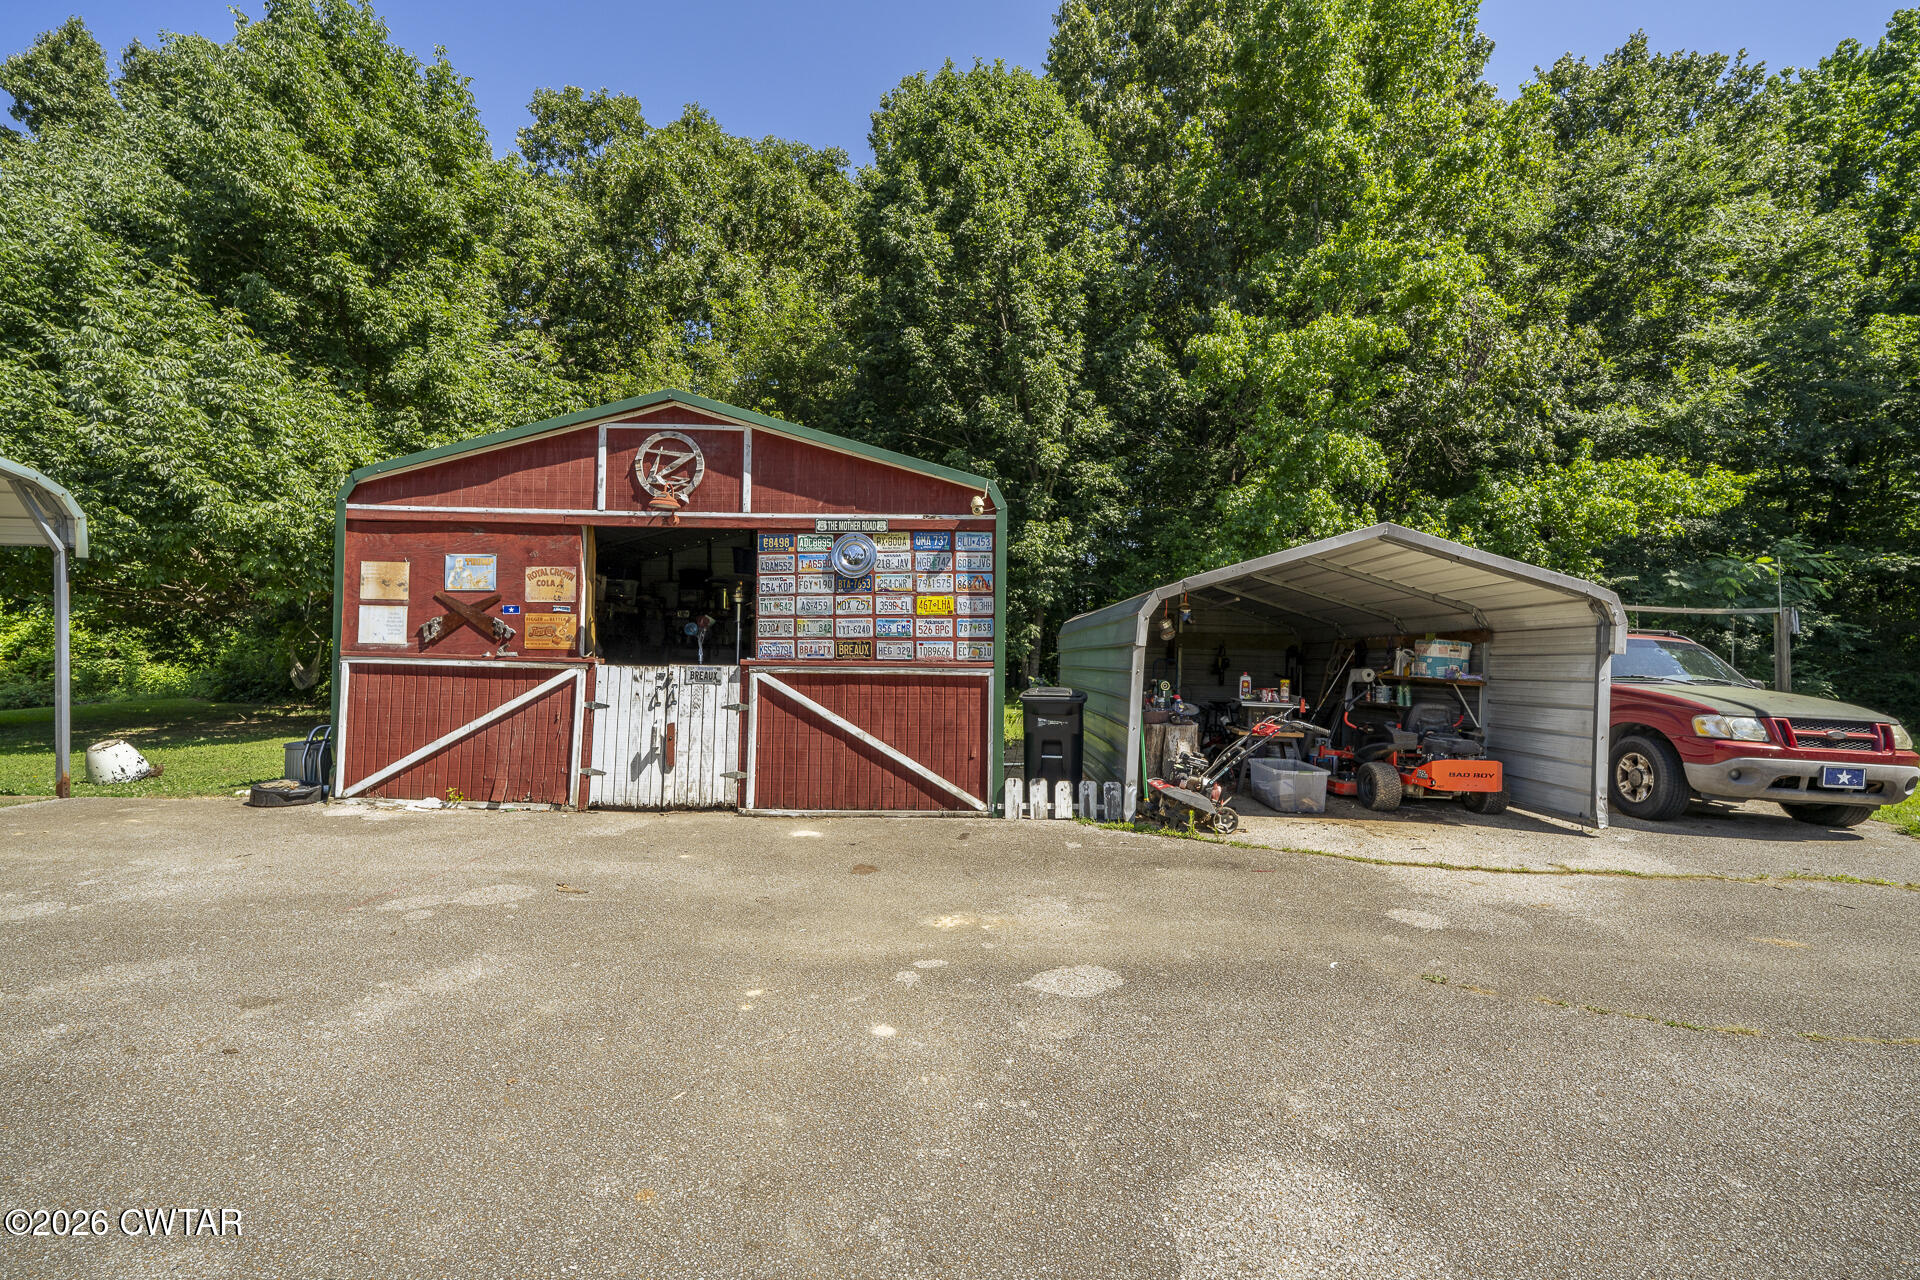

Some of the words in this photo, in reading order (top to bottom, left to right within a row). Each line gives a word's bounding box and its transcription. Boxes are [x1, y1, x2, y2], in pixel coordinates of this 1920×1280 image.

[828, 521, 838, 530] THE
[839, 521, 860, 530] MOTHER
[862, 521, 876, 531] ROAD
[527, 568, 548, 581] ROYAL
[550, 568, 575, 581] CROWN
[839, 644, 870, 655] BREAUX
[690, 671, 718, 680] BREAUX
